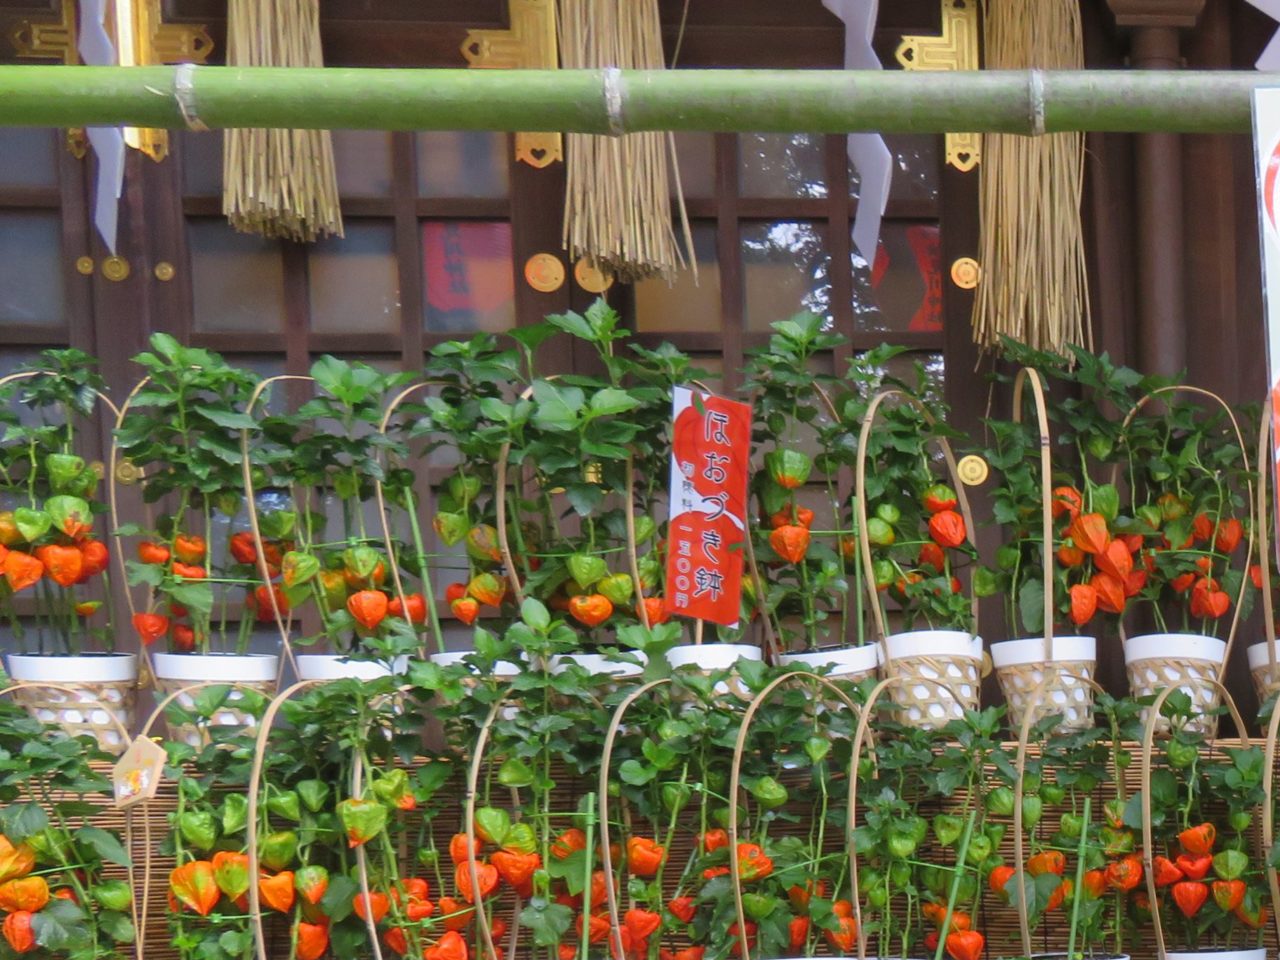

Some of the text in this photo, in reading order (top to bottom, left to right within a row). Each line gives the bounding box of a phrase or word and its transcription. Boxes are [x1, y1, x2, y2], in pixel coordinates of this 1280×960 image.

[693, 411, 731, 601] ほおづき鉢
